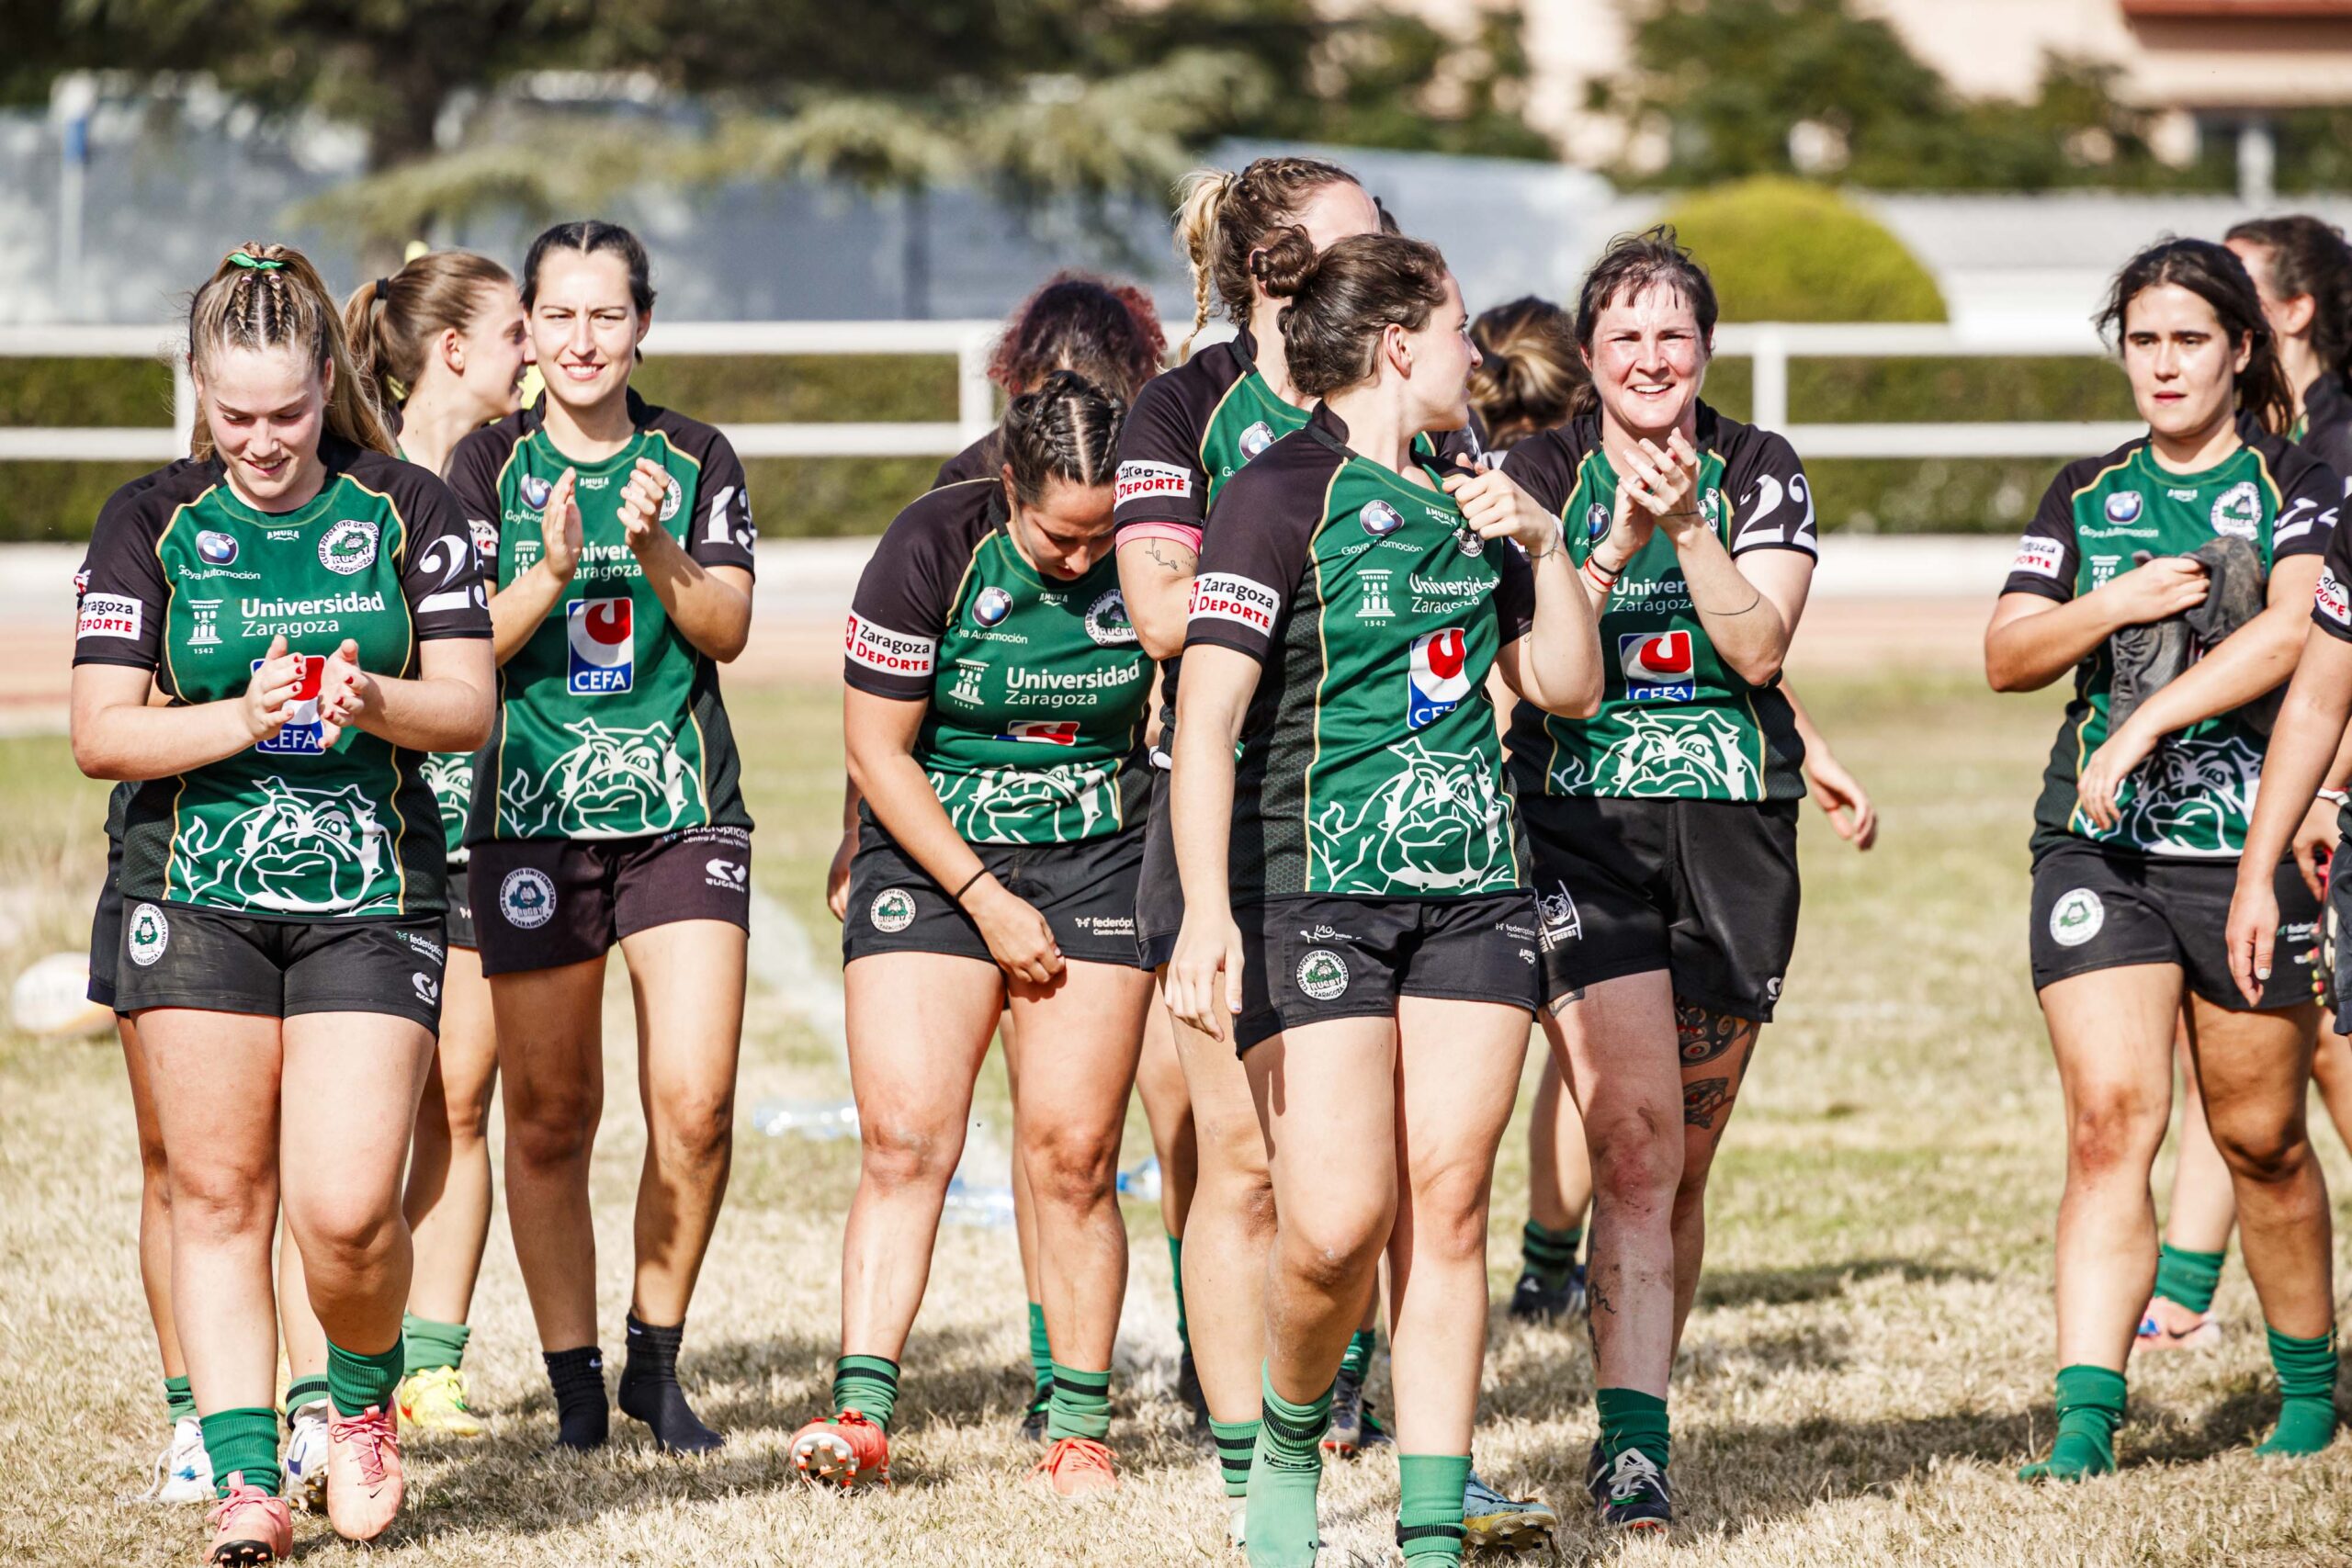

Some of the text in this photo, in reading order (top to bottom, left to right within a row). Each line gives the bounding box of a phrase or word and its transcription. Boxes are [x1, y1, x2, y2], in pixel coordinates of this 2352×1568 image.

[1119, 478, 1185, 500] DEPORTE
[1425, 506, 1457, 525] AMURA
[1733, 473, 1818, 553] 22
[266, 530, 300, 540] AMURA
[1341, 541, 1370, 556] Goya
[202, 569, 261, 580] Automoción
[573, 564, 643, 581] aragoza
[1203, 578, 1274, 610] Zaragoza
[1612, 577, 1691, 595] Univer
[82, 599, 134, 615] aragoza
[242, 591, 386, 618] Universidad
[1199, 595, 1270, 628] DEPORTE
[242, 619, 340, 637] Zaragoza
[1364, 619, 1386, 627] 1542
[860, 624, 931, 655] Zaragoza
[970, 629, 1028, 644] Automoción
[194, 647, 214, 655] 1542
[856, 641, 929, 671] DEPORTE
[574, 671, 627, 691] CEFA
[1006, 658, 1140, 690] Universidad
[1004, 690, 1098, 708] Zaragoza
[264, 729, 318, 750] CEFA
[1316, 924, 1333, 934] IAO
[1309, 976, 1342, 991] RUGBY
